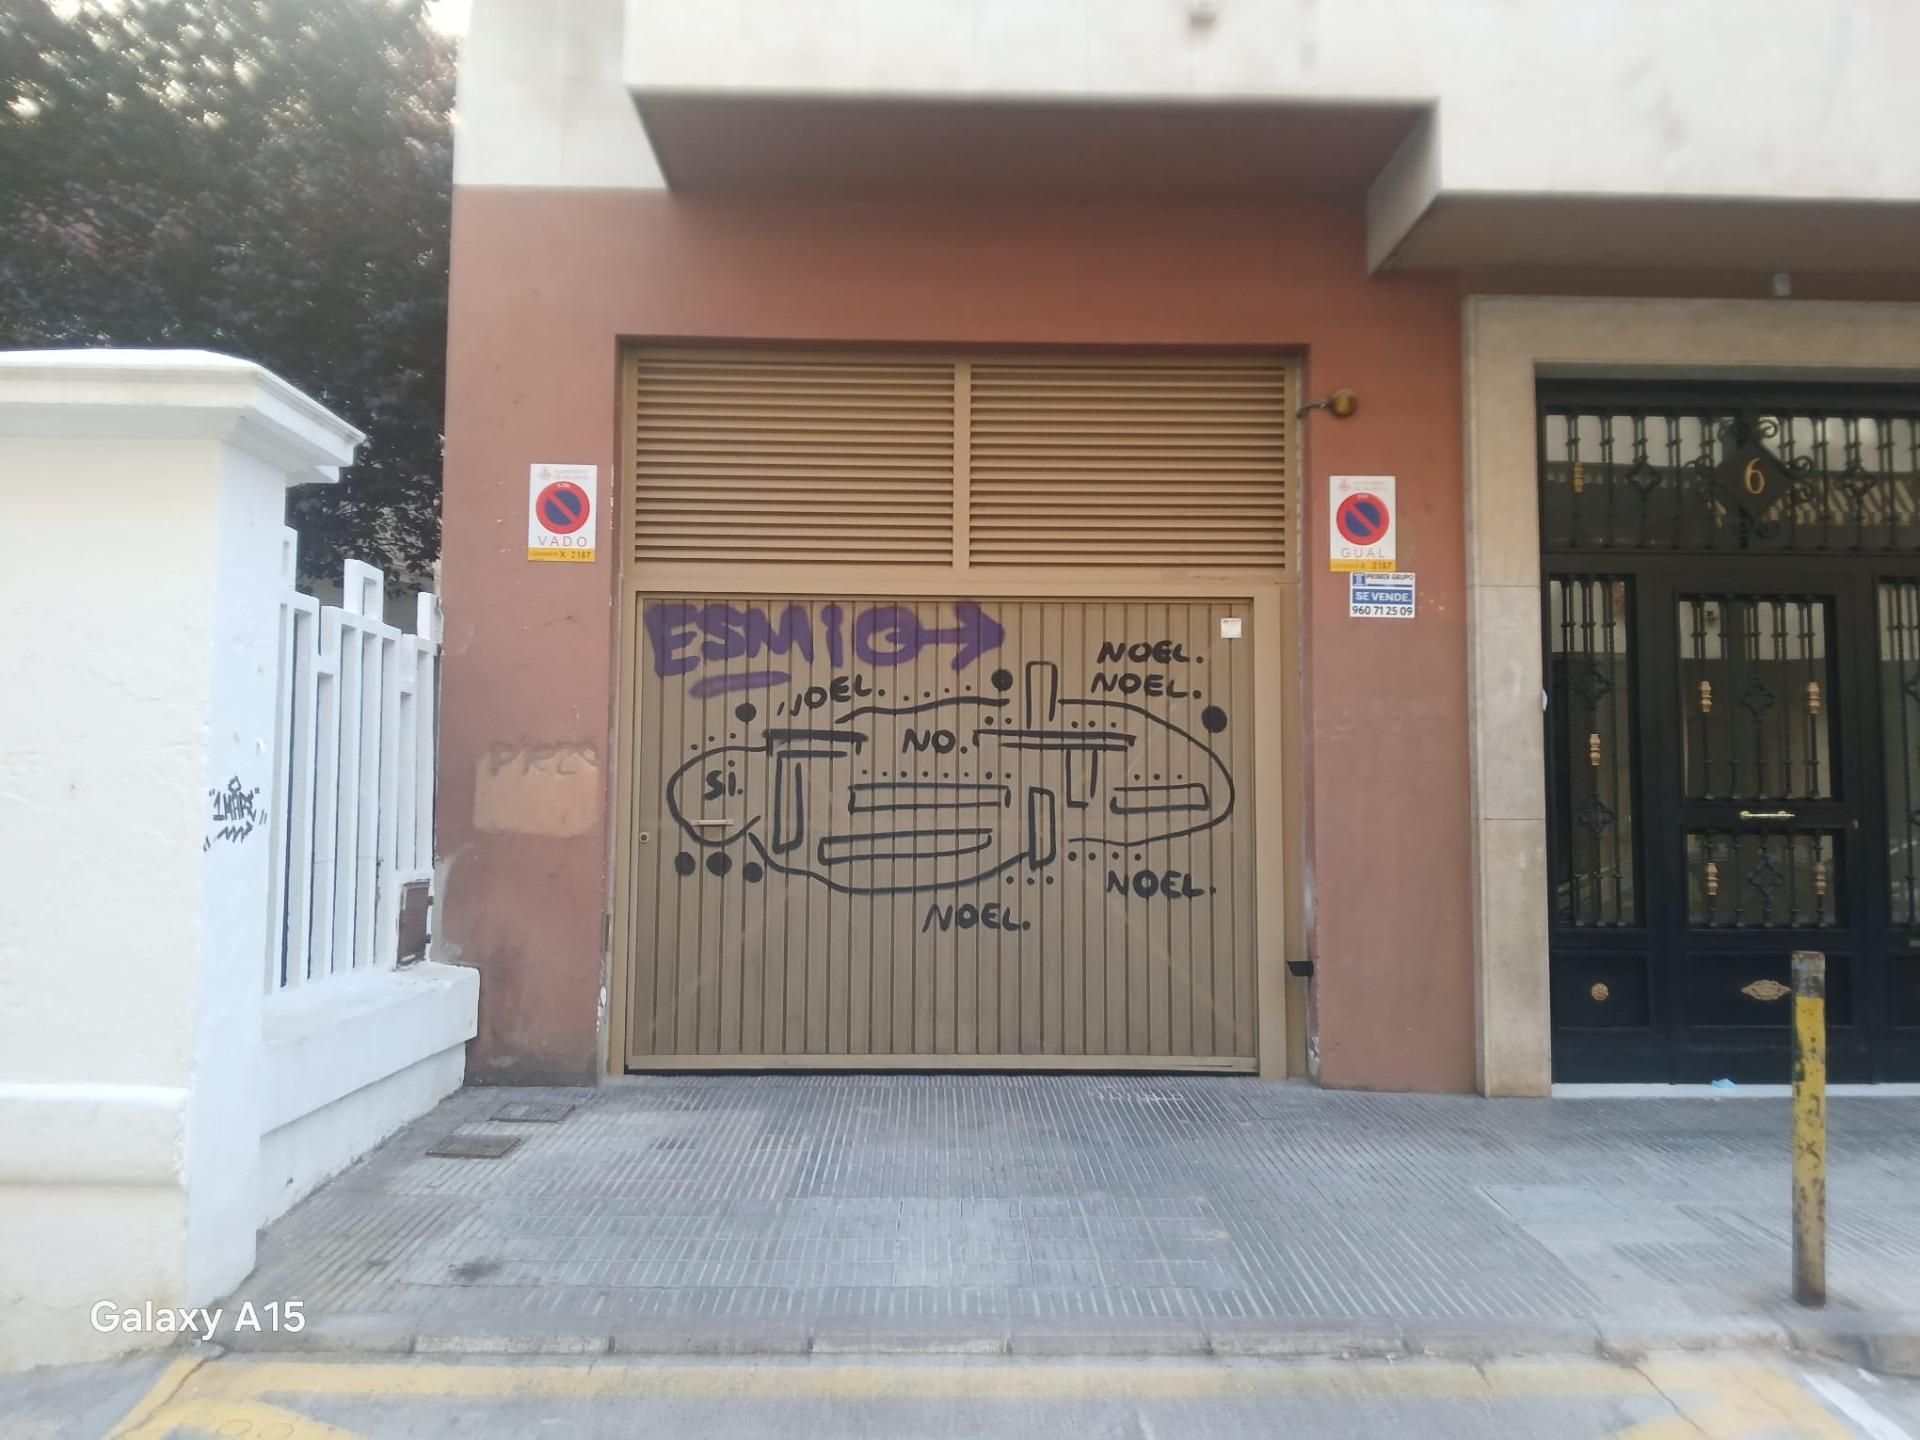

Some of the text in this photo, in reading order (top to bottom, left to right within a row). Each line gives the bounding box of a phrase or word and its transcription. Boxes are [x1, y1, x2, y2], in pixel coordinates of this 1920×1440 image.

[1746, 458, 1765, 494] 6
[537, 535, 588, 547] VADO
[1341, 547, 1385, 558] GUAL
[1355, 591, 1370, 601] SE
[1352, 605, 1413, 616] 960 71 25 09
[1096, 640, 1204, 664] NOEL.
[1091, 672, 1202, 699] NOEL.
[1106, 869, 1217, 898] NOEL.
[922, 903, 1031, 933] NOEL.
